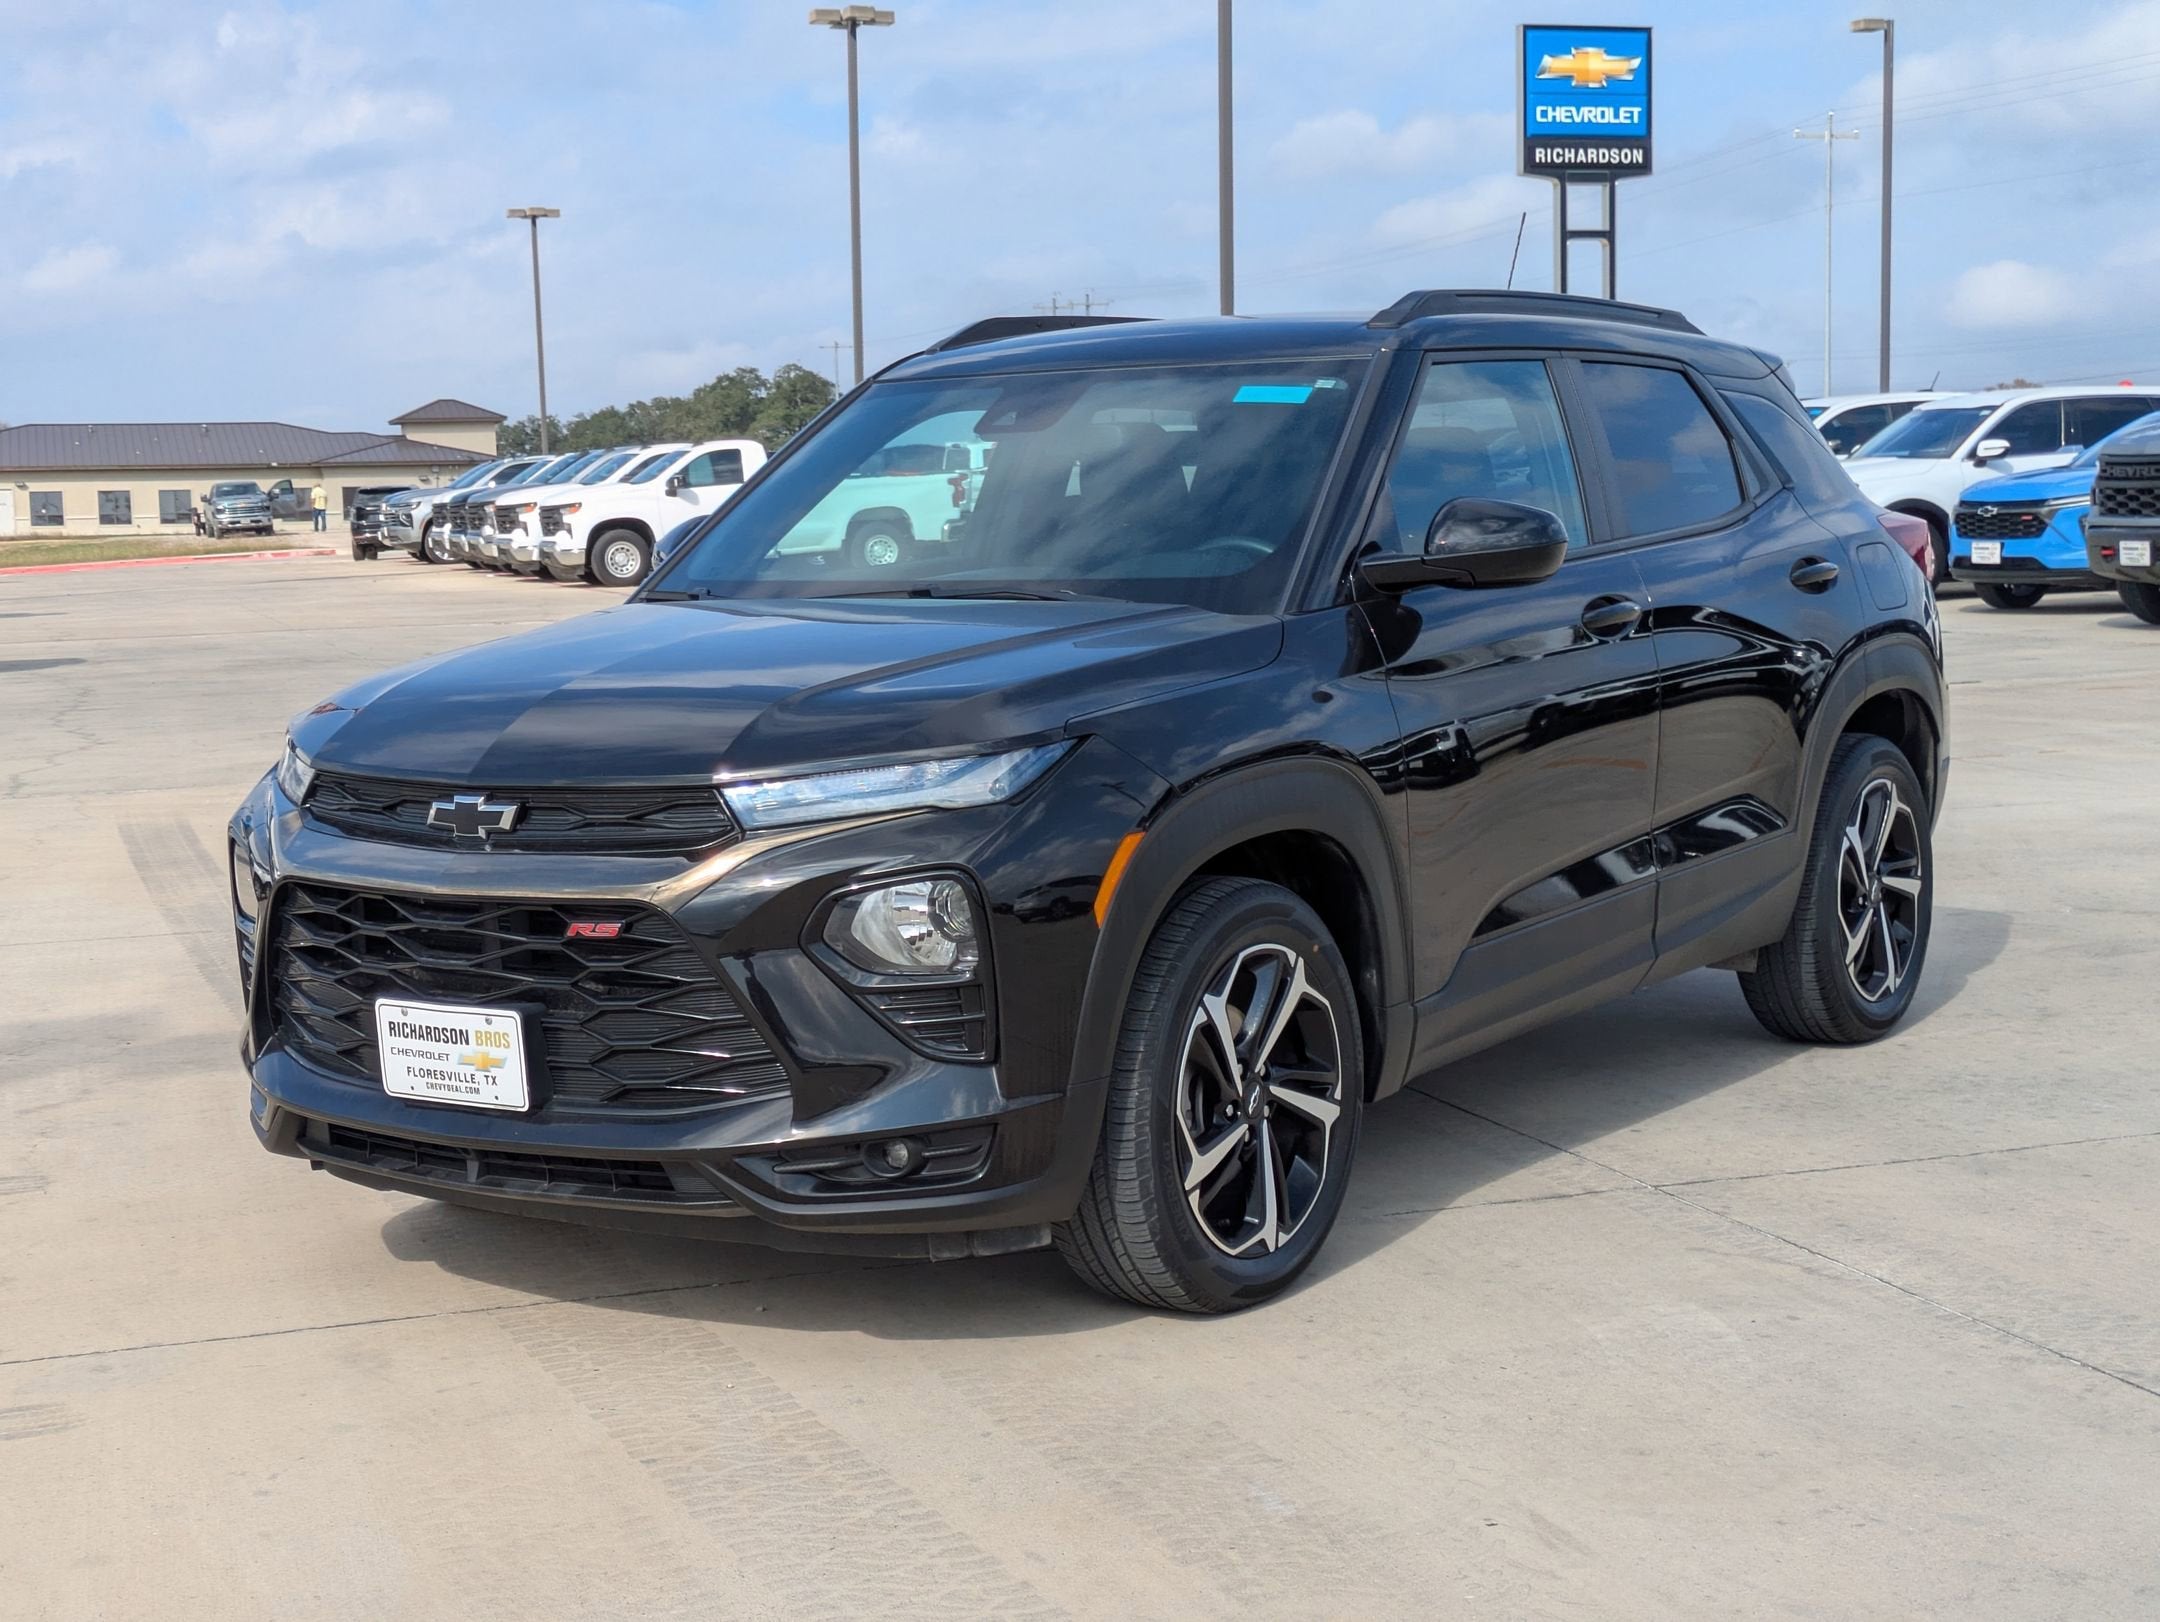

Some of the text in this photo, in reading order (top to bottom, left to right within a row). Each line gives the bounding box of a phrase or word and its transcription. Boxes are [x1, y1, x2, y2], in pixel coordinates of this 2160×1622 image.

[1536, 105, 1642, 124] CHEVROLET
[1535, 147, 1644, 164] RICHARDSON
[566, 922, 622, 937] RS
[388, 1020, 511, 1049] RICHARDSON BROS
[390, 1046, 451, 1062] CHEVROLET
[406, 1066, 498, 1086] FLORESVILLE, TX
[425, 1081, 481, 1095] CHEVYDEAL.COM
